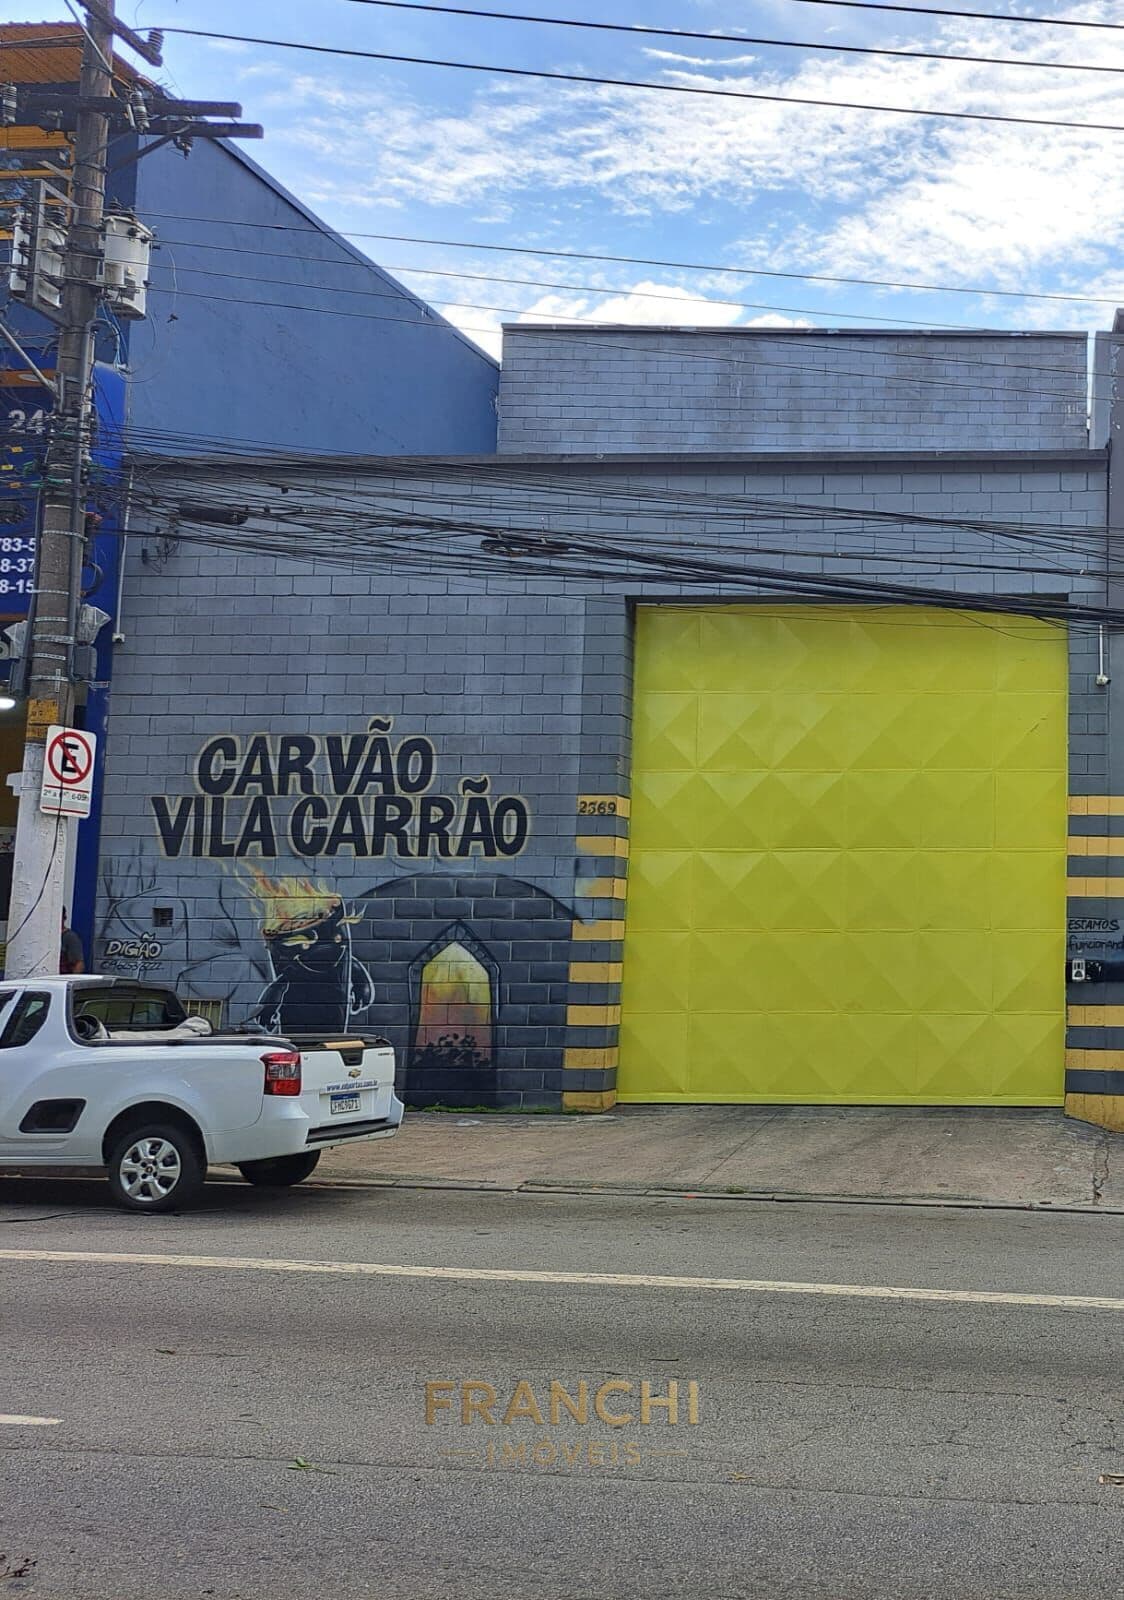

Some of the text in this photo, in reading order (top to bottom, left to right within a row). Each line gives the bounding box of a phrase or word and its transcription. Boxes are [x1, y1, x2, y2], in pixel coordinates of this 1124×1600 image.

[195, 716, 436, 796] CARVÃO
[152, 795, 277, 858] VILA
[289, 775, 531, 858] CARRÃO
[105, 932, 162, 958] DIGÃO
[1068, 919, 1120, 931] ESTAMOS
